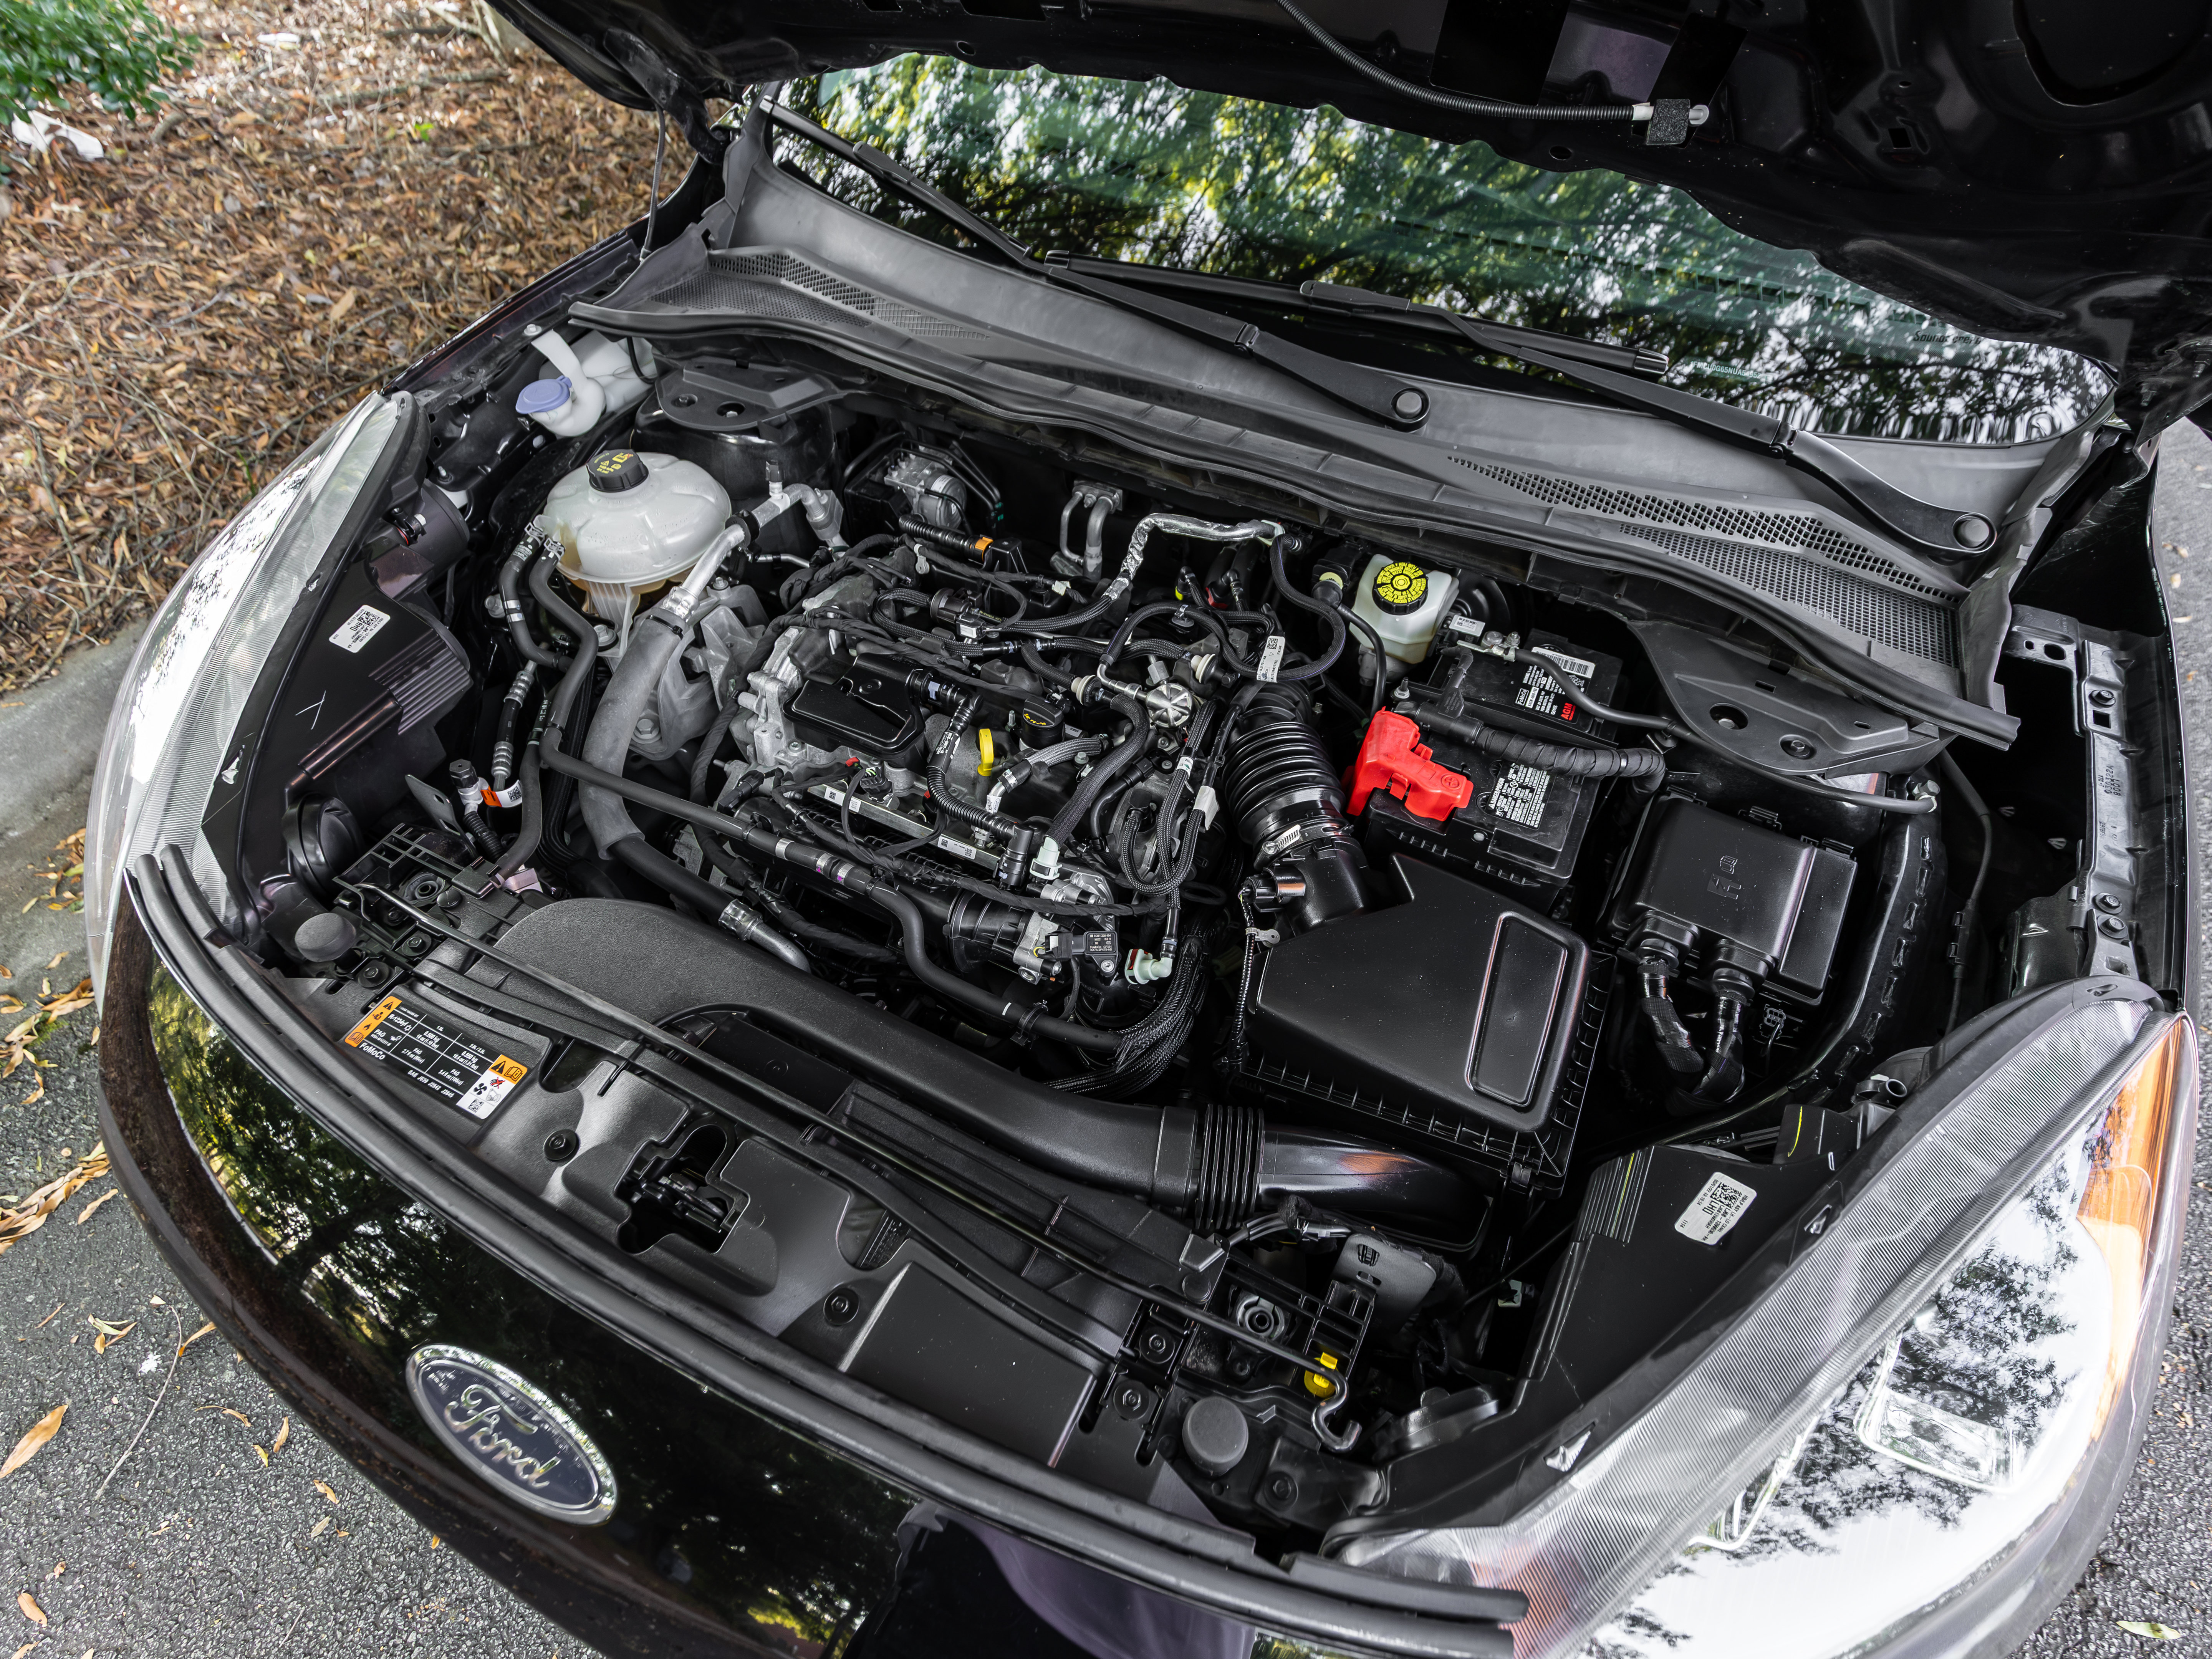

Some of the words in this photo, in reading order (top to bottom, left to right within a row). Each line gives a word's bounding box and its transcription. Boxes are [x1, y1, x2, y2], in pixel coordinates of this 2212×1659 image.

[1518, 689, 1527, 704] FoMoCo
[1561, 703, 1572, 719] AGM
[359, 1043, 385, 1059] FoMoCo
[444, 1384, 561, 1488] Ford
